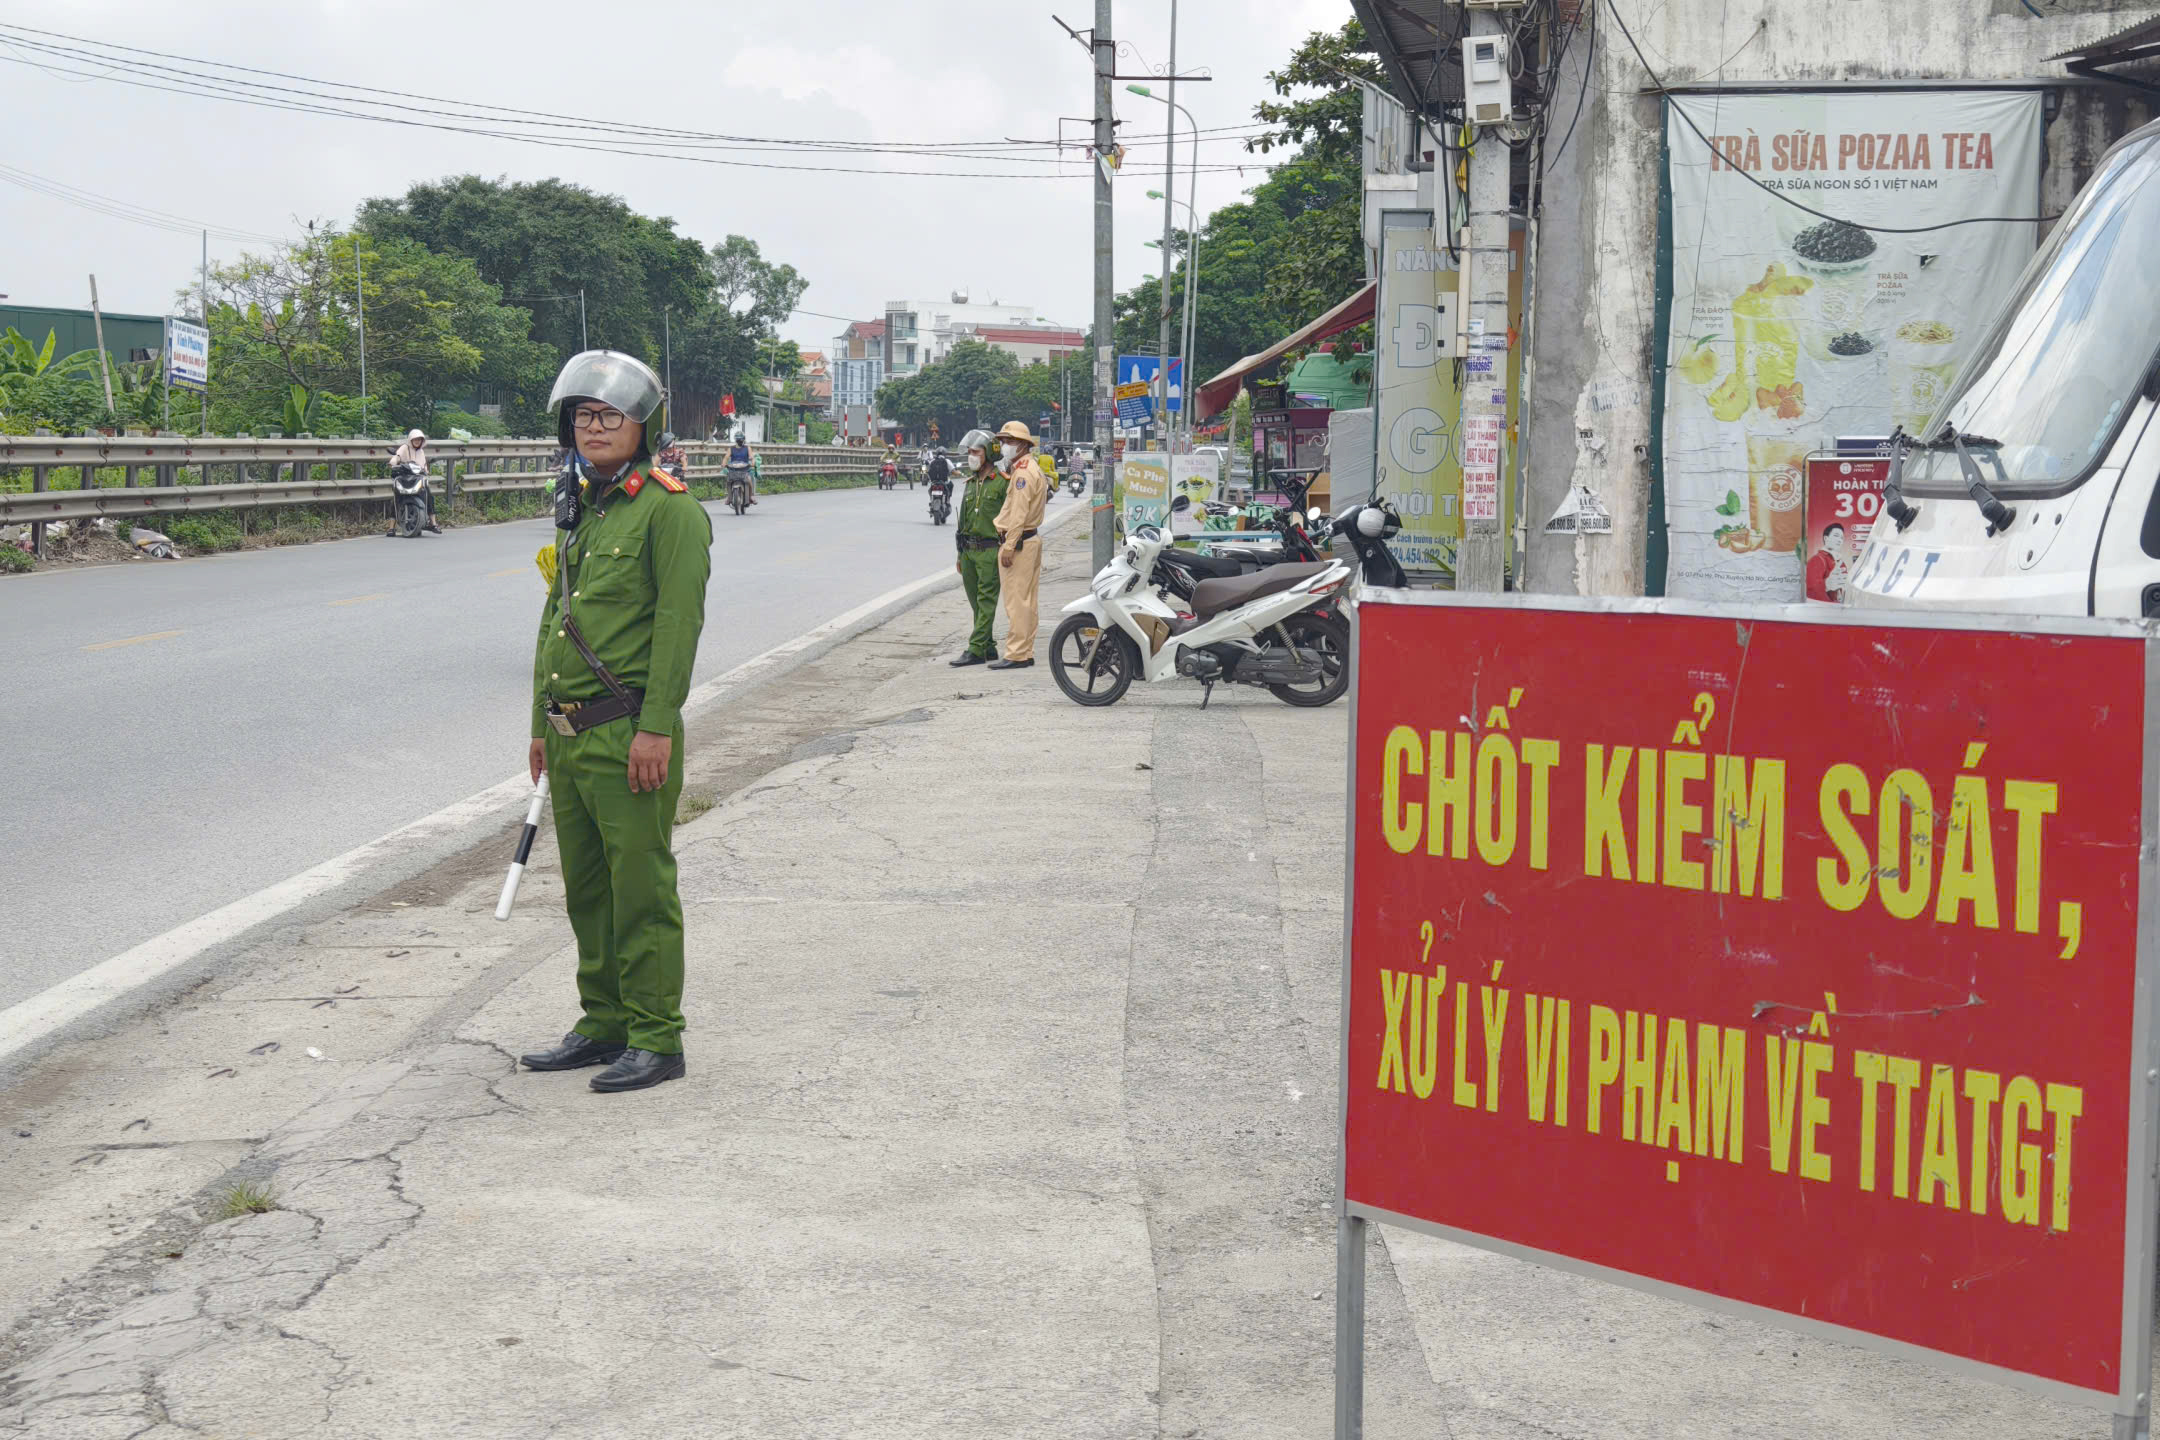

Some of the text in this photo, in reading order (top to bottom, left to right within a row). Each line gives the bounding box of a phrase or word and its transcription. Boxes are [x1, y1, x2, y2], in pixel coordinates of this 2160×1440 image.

[1708, 128, 1993, 171] TRÀ SỮA POZAA TEA
[1787, 177, 1811, 190] SỮA
[1814, 179, 1850, 190] NGON
[1853, 176, 1872, 190] SỐ
[1874, 179, 1879, 189] 1
[1882, 177, 1908, 191] VIỆT
[1910, 179, 1938, 189] NAM
[1390, 407, 1460, 474] G
[1833, 477, 1886, 490] HOÀN TI
[1390, 488, 1433, 520] NỘI
[1835, 492, 1886, 518] 30
[1384, 688, 2080, 958] CHỐT KIỂM SOÁT,
[1378, 921, 2082, 1231] XỬ LÝ VI PHẠM VỀ TTATGT
